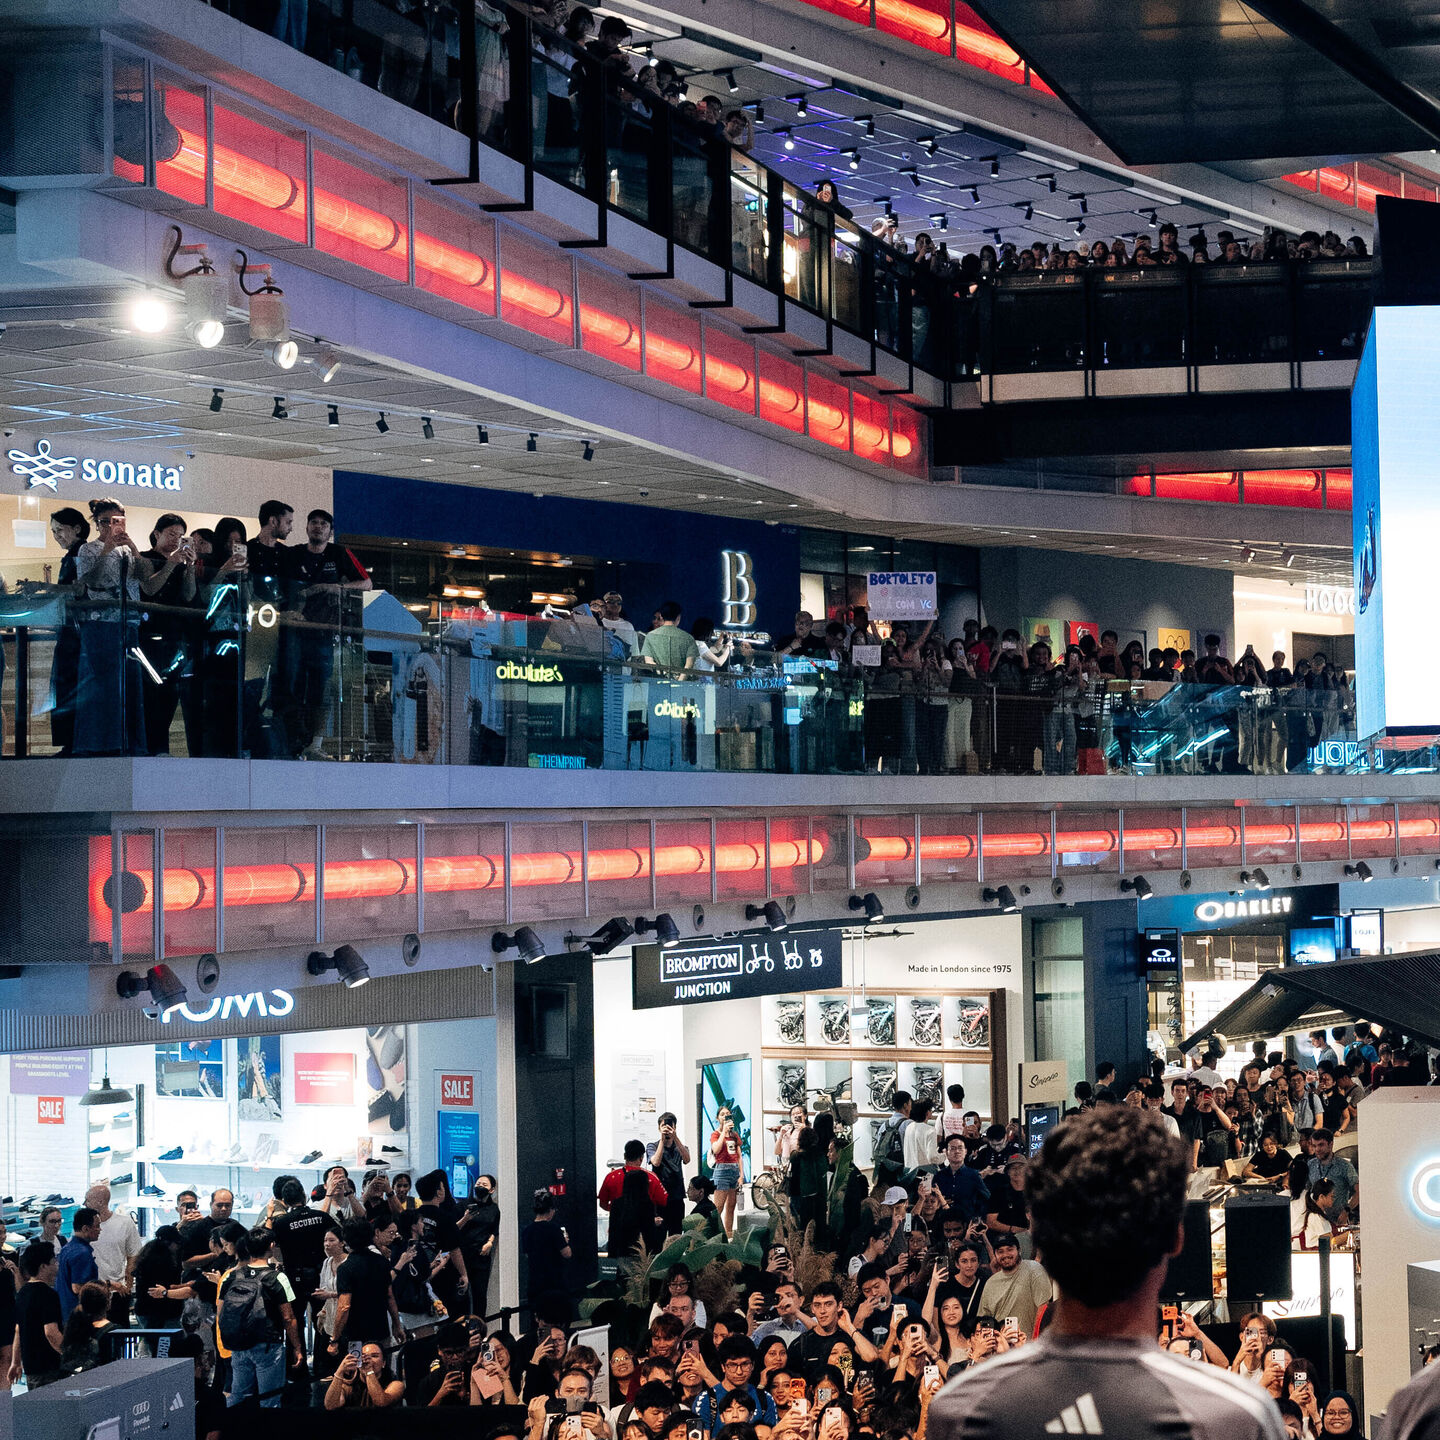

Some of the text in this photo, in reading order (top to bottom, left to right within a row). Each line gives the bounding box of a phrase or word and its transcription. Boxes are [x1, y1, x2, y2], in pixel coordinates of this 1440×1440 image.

[81, 458, 183, 491] sonata
[869, 573, 935, 585] BORTOLETO
[895, 600, 915, 610] COM
[1223, 897, 1293, 918] OAKLEY
[665, 953, 738, 974] BROMPTON
[993, 965, 1012, 973] 1975
[1147, 956, 1176, 964] OAKLEY
[674, 981, 731, 999] JUNCTION
[161, 989, 294, 1024] OMS
[444, 1080, 471, 1099] SALE
[39, 1101, 62, 1119] SALE
[289, 1216, 323, 1231] SECURITY
